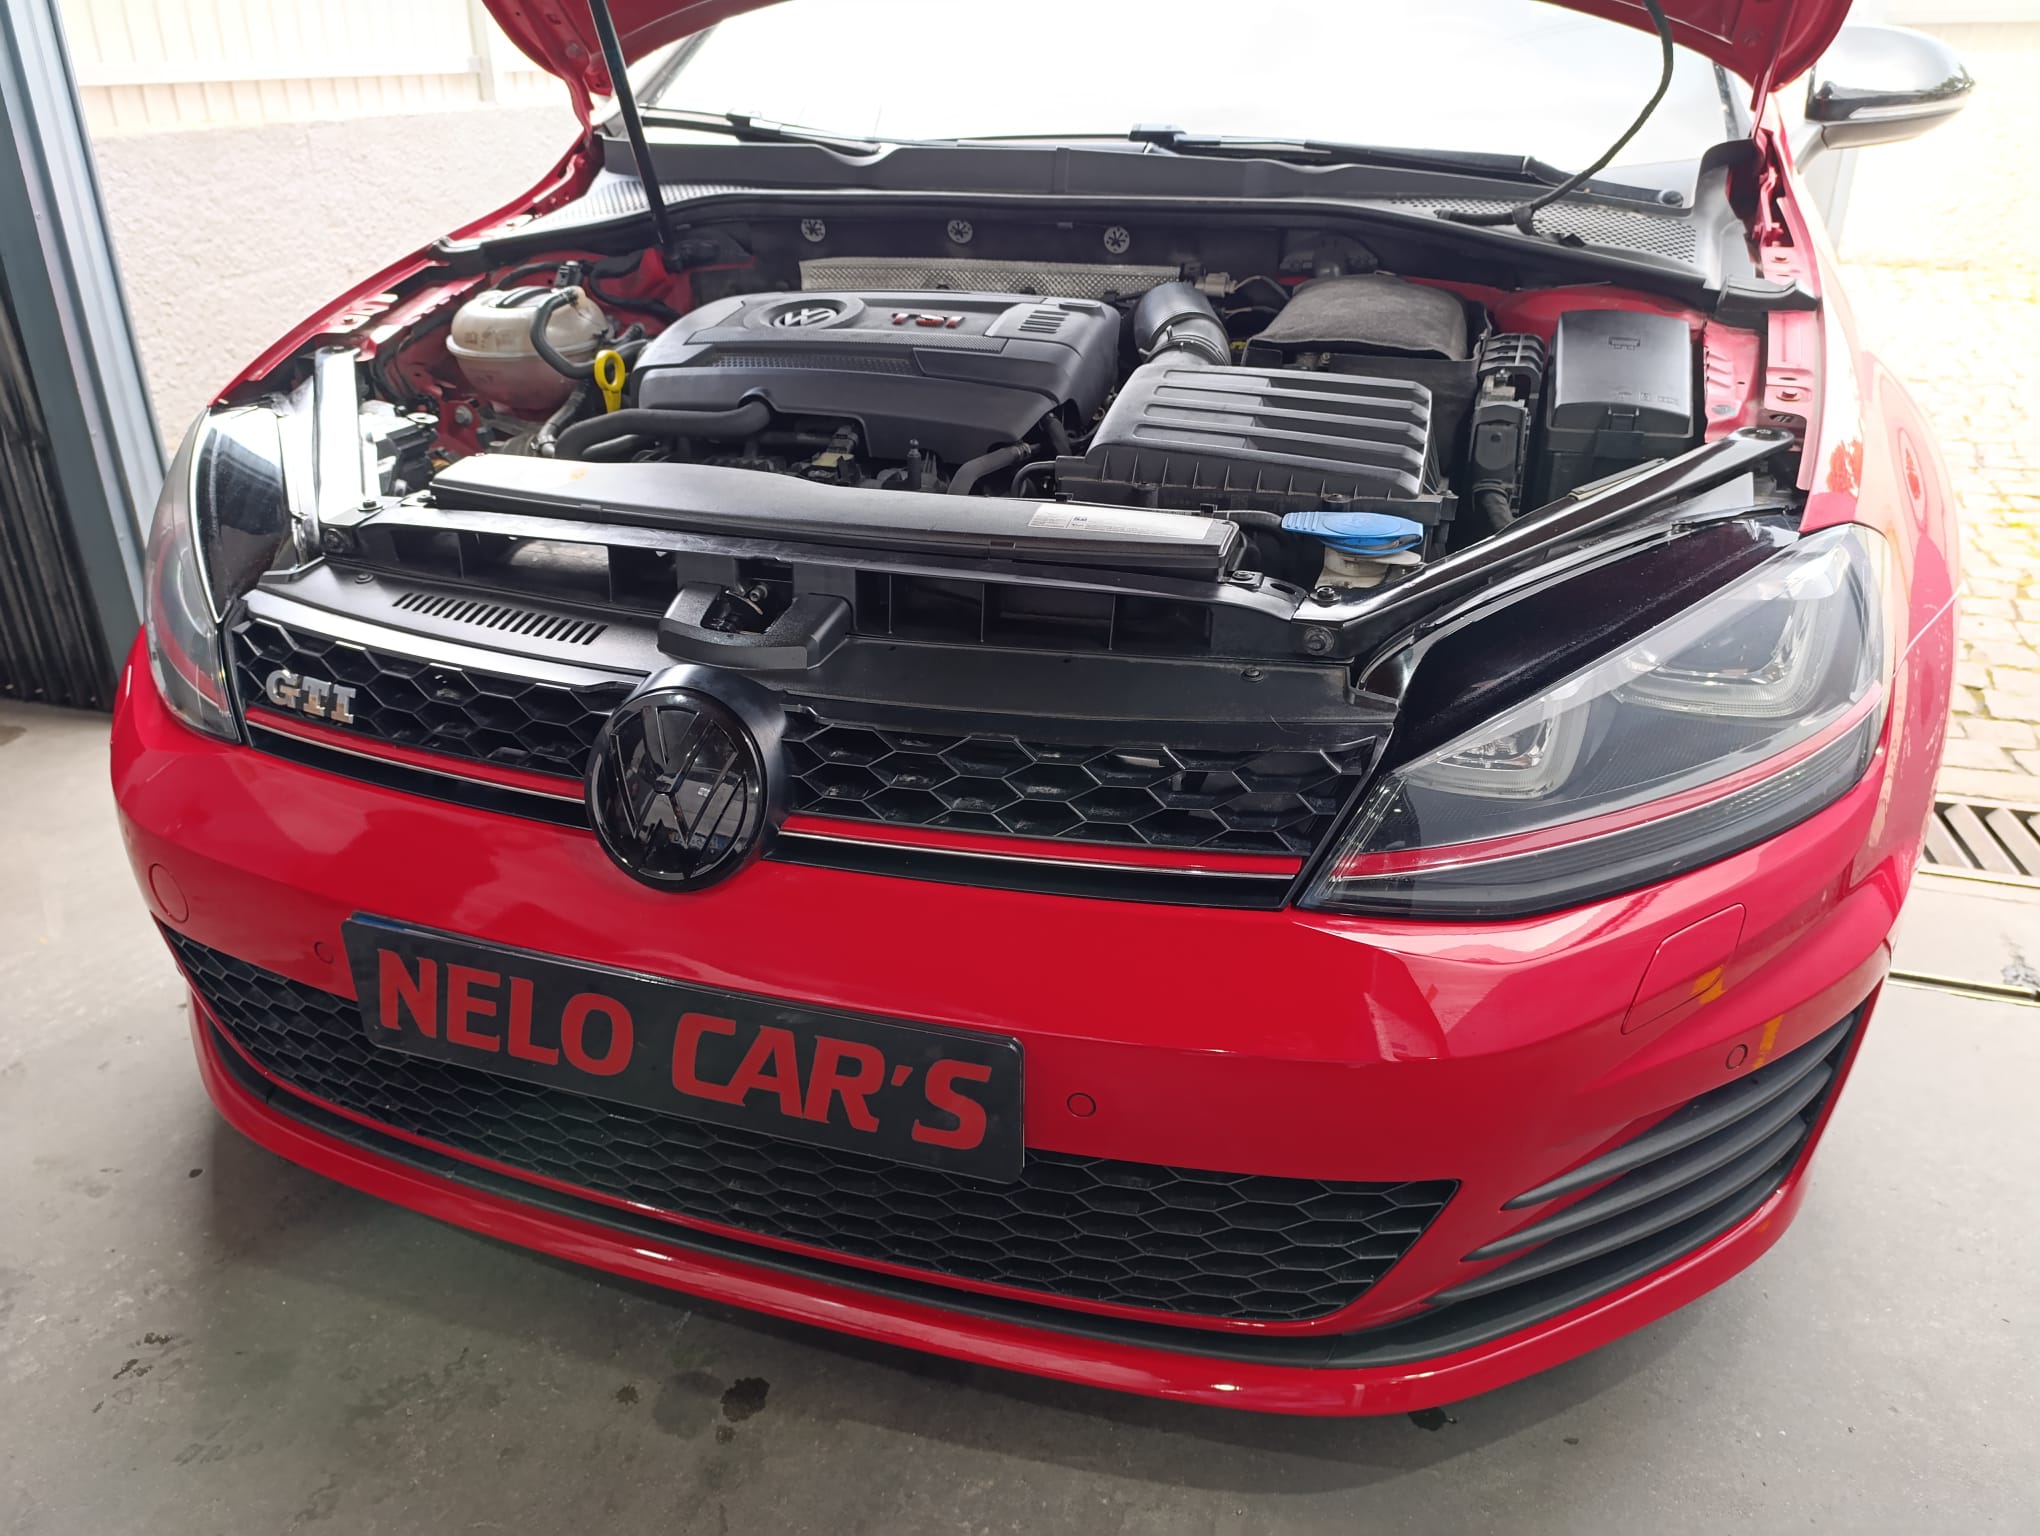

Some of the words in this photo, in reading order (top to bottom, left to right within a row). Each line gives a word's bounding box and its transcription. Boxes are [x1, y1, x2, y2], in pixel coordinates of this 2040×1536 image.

[892, 312, 965, 329] TSI
[266, 669, 356, 724] GTI
[375, 947, 634, 1076] NELO
[671, 1011, 992, 1151] CAR'S
